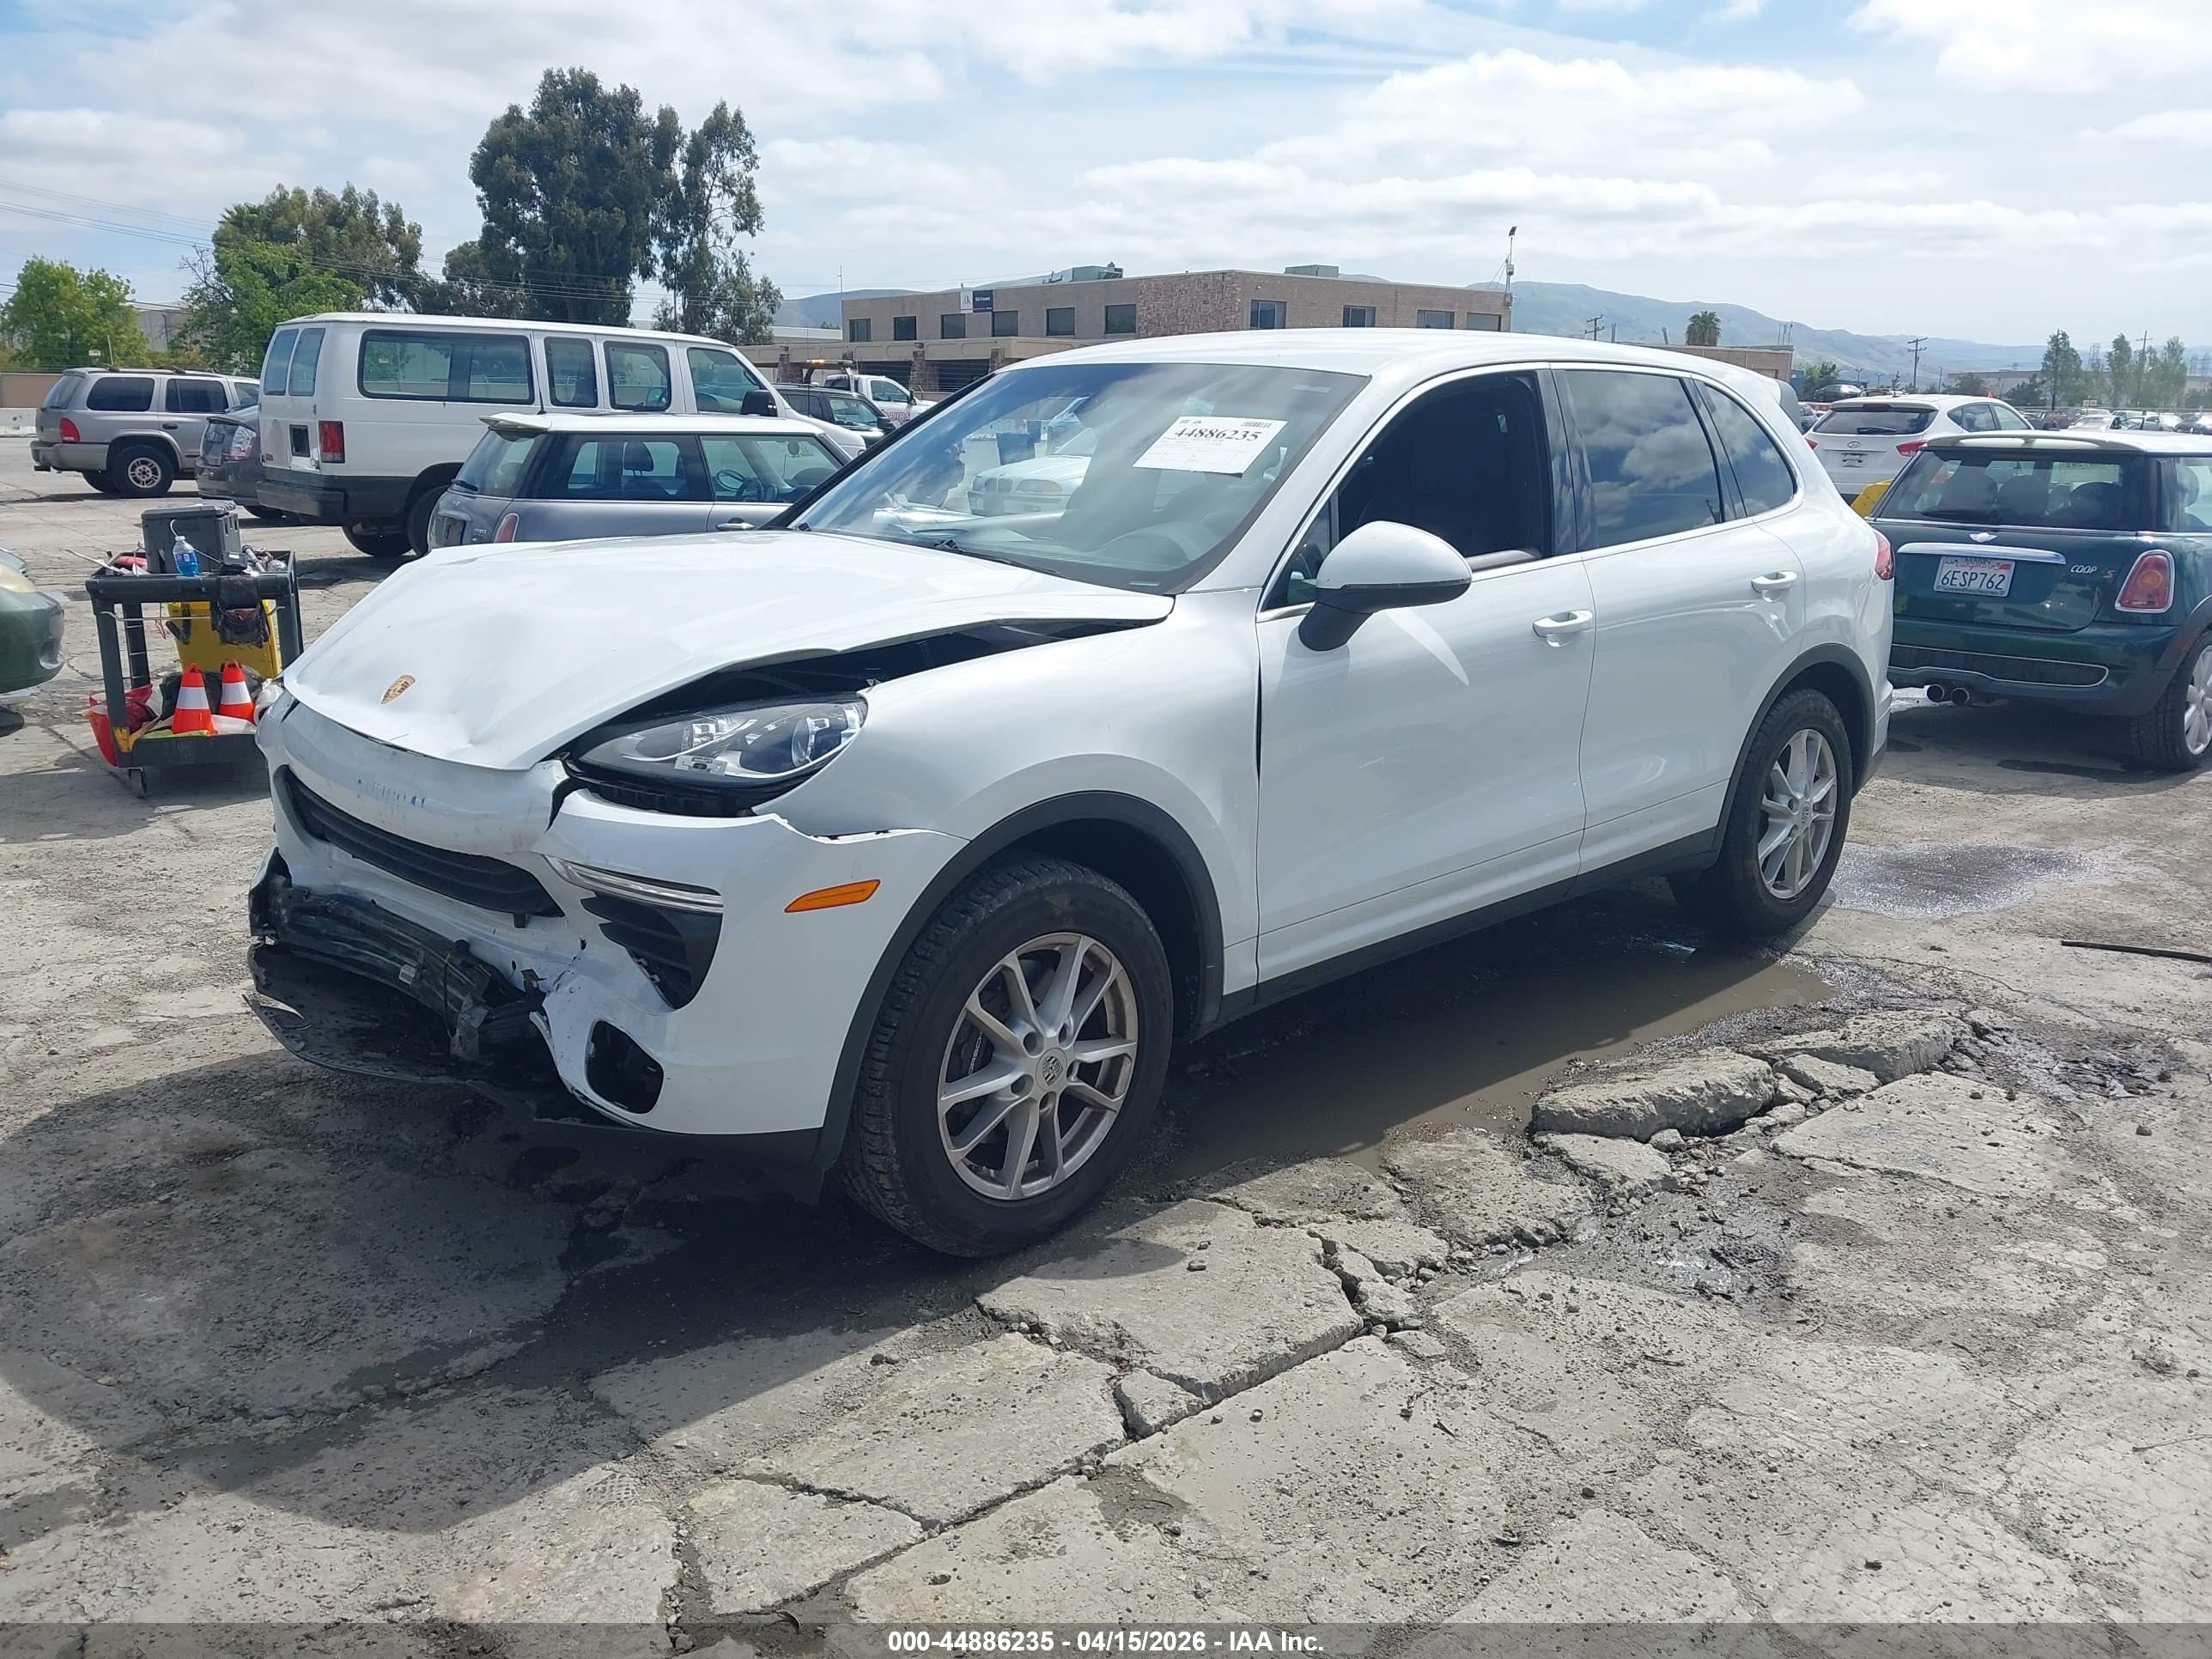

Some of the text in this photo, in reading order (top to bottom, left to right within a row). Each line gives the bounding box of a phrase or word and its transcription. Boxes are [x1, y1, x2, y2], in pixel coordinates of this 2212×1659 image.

[1175, 428, 1263, 441] 44886235
[2070, 564, 2117, 578] COOP S
[1941, 570, 2006, 590] 6ESP762
